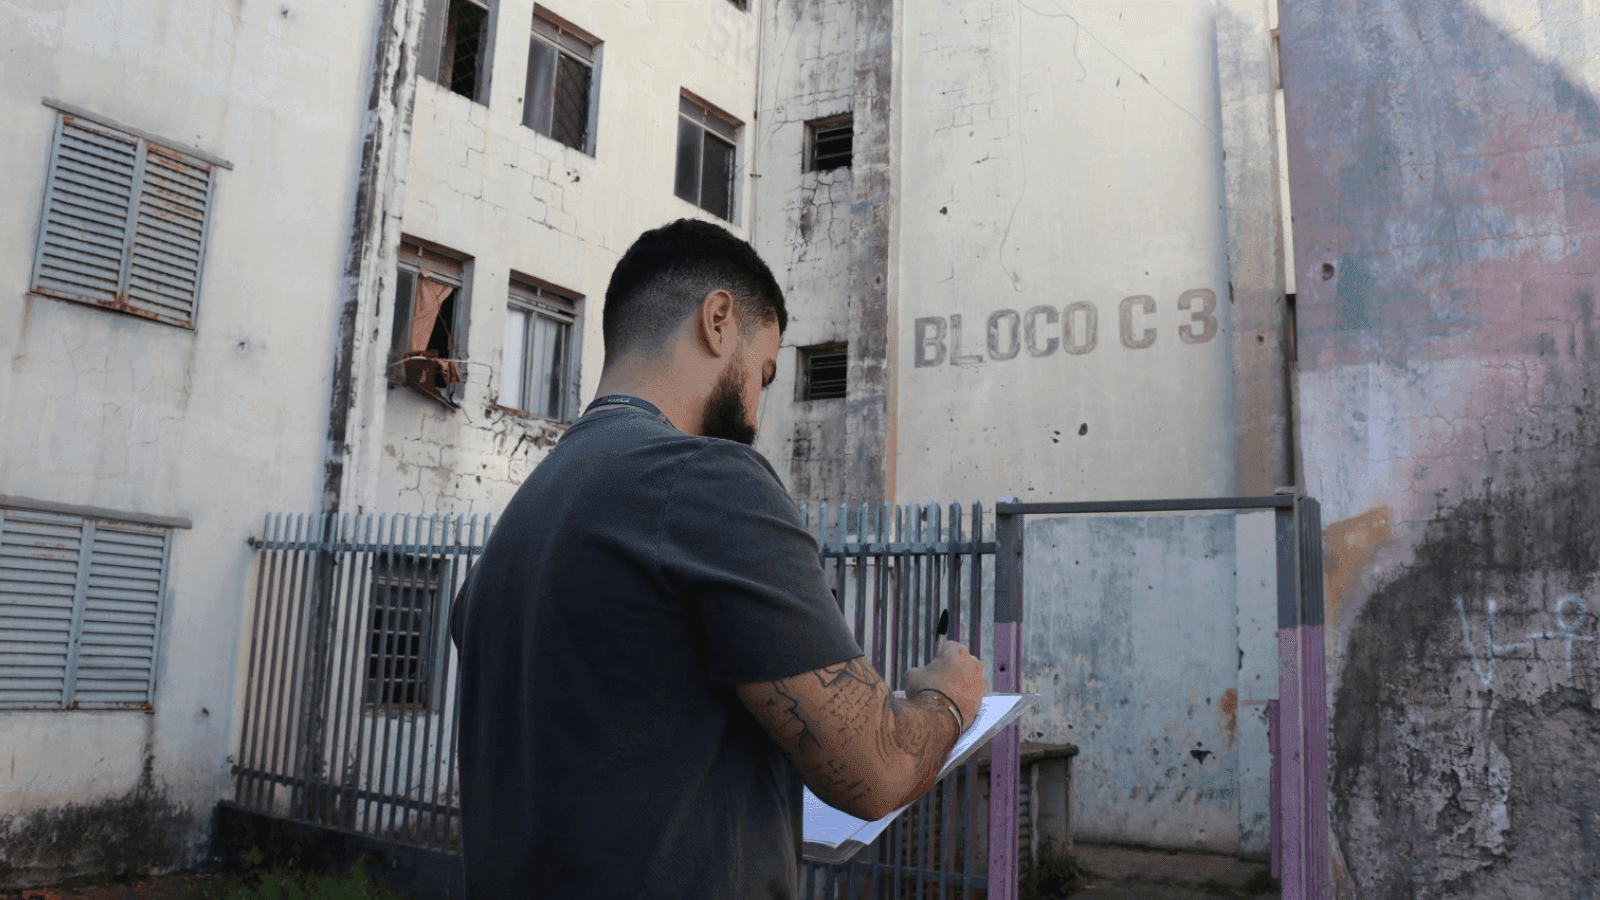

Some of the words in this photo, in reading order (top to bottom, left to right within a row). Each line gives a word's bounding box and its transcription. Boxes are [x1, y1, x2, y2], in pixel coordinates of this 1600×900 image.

[914, 300, 1098, 369] BLOCO
[1118, 294, 1158, 350] C
[1177, 287, 1218, 345] 3
